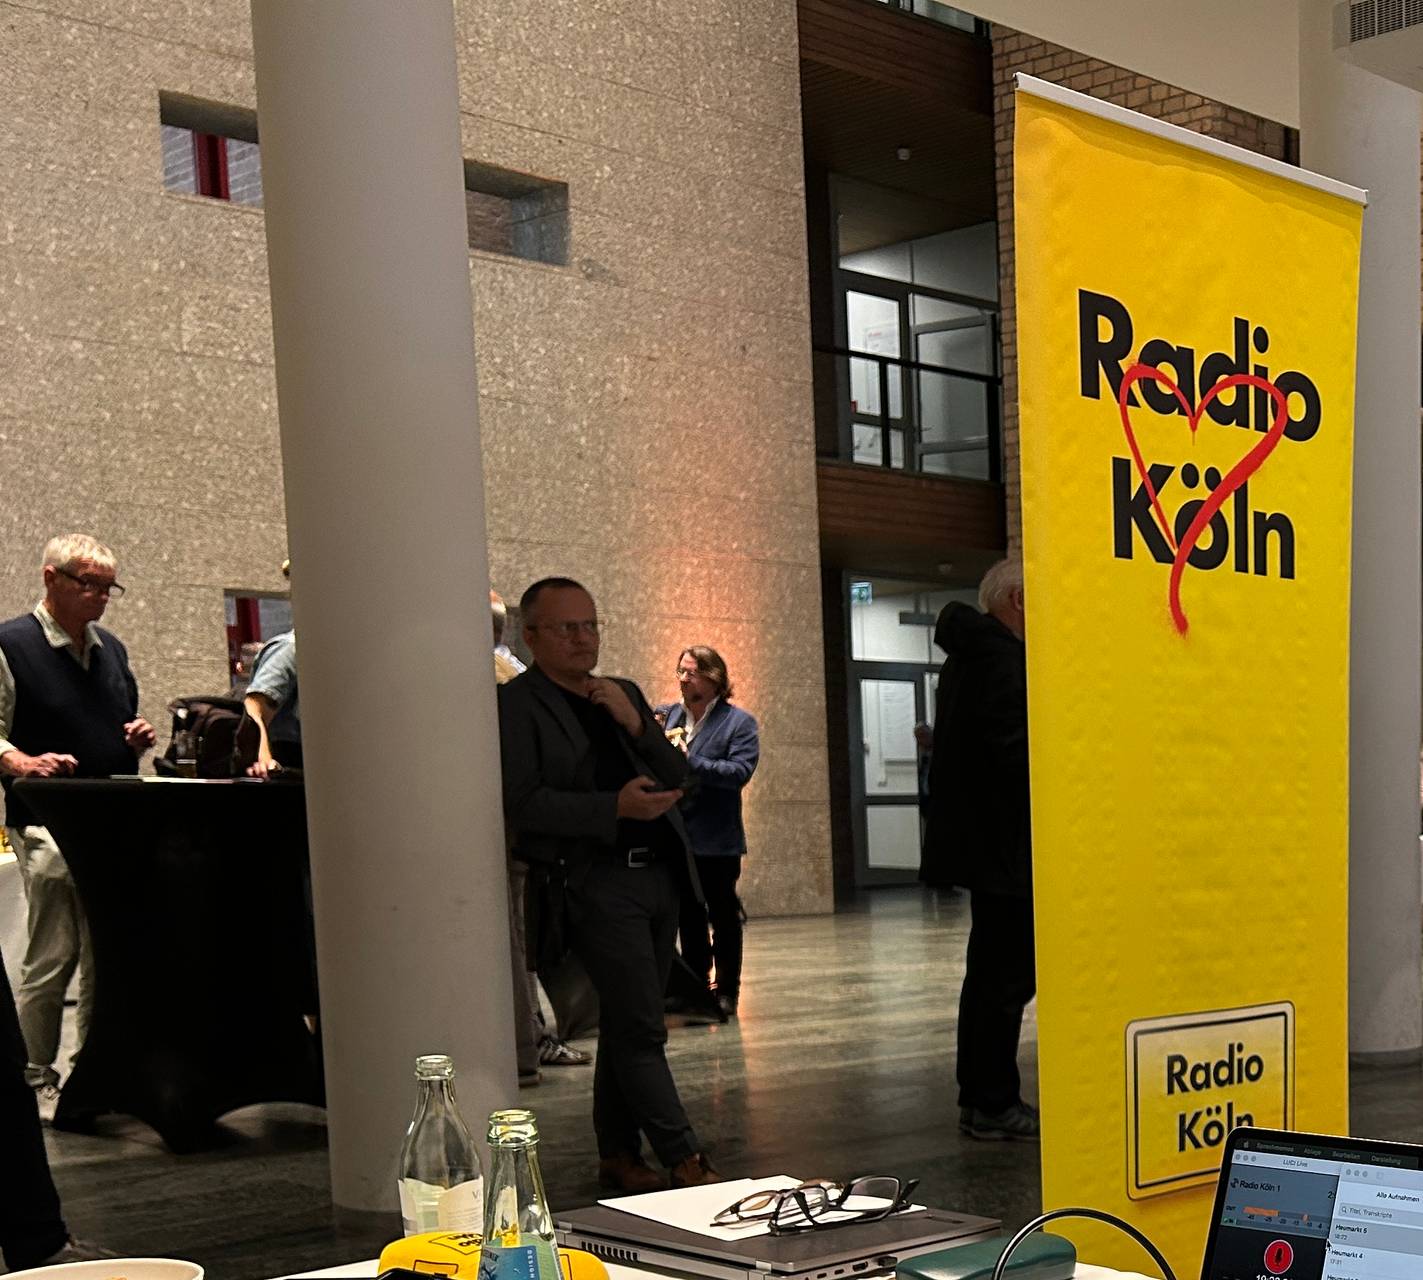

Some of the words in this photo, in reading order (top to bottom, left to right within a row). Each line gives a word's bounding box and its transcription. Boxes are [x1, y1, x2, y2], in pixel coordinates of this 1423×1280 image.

[1078, 288, 1322, 442] Radio
[1111, 456, 1296, 581] Köln
[1166, 1042, 1264, 1096] Radio
[1239, 1180, 1259, 1190] Radio
[1259, 1183, 1275, 1191] Köln
[1376, 1191, 1387, 1200] Alle
[1388, 1193, 1420, 1202] Aufnahmen
[1335, 1223, 1362, 1233] Heumarkt
[527, 1249, 536, 1279] DESIGN
